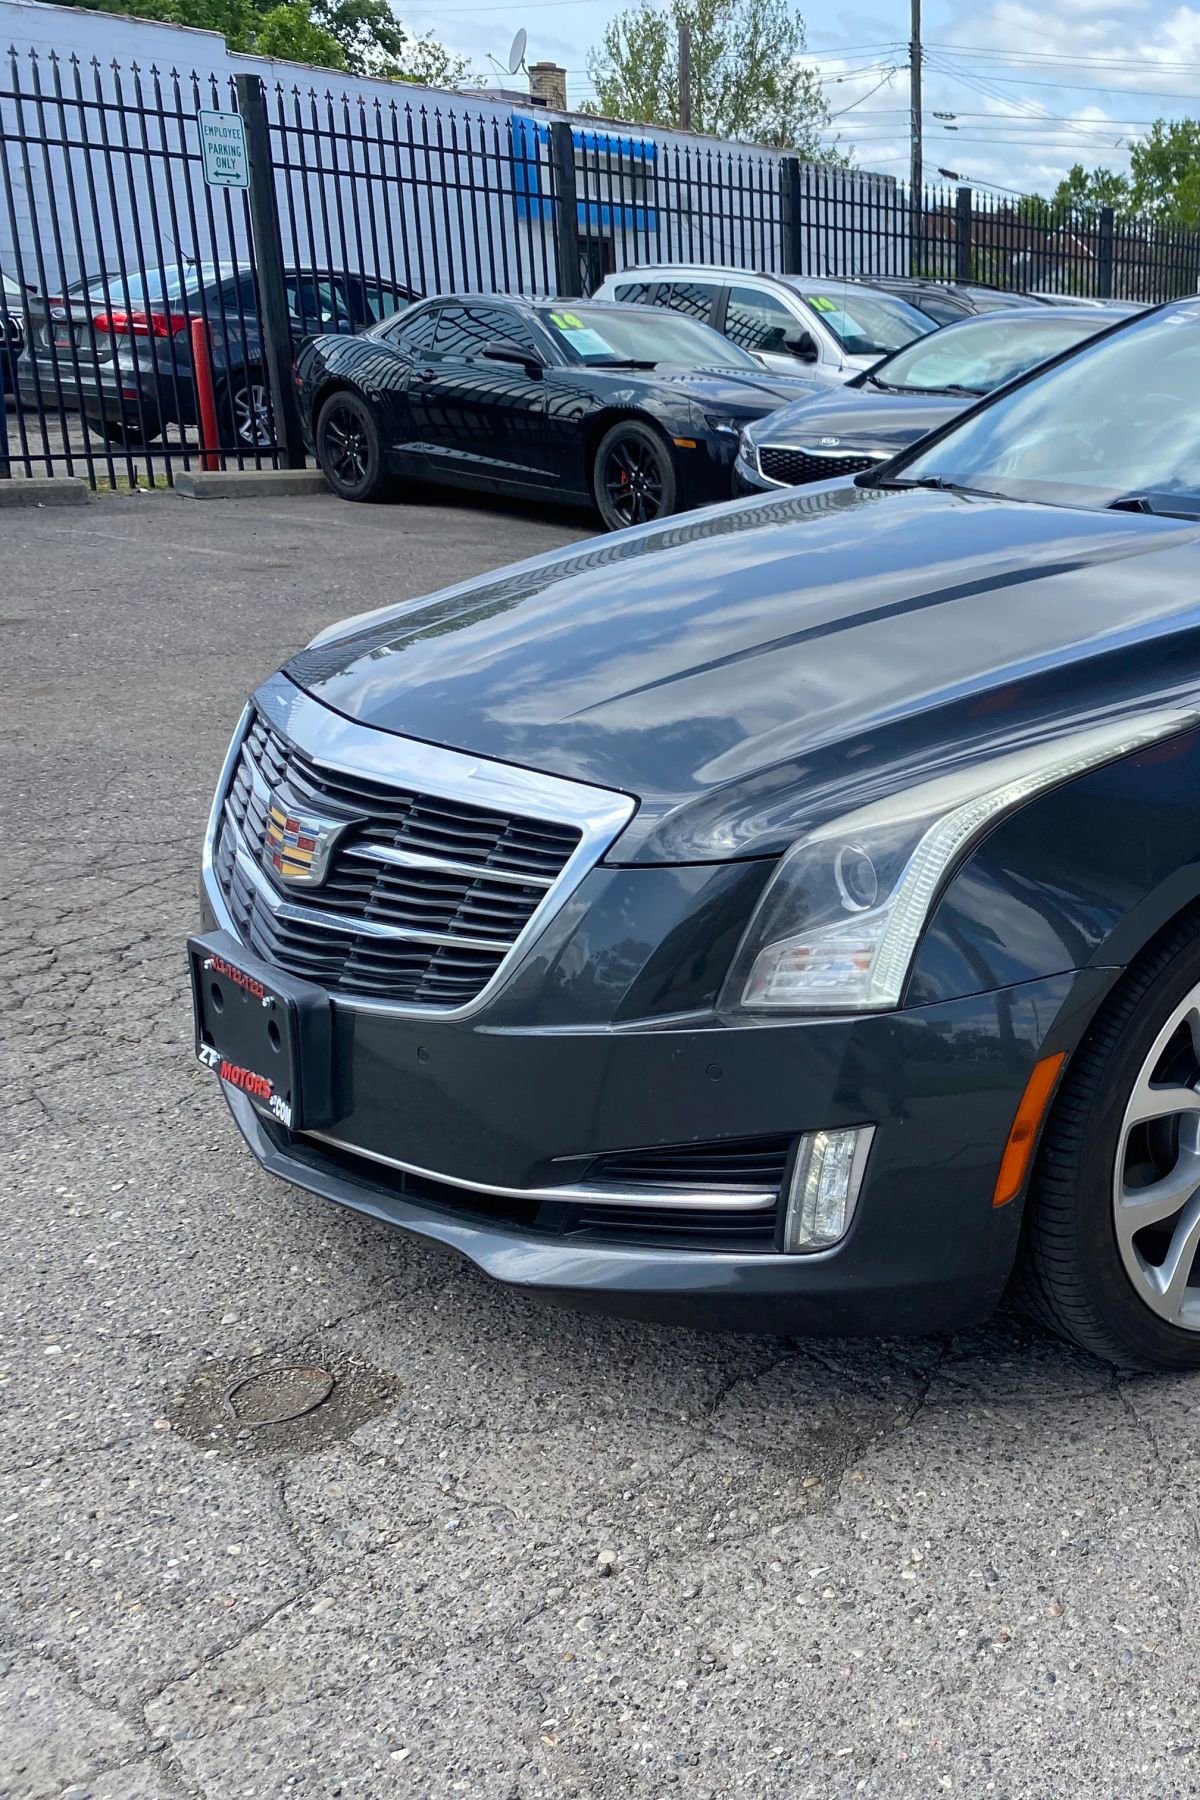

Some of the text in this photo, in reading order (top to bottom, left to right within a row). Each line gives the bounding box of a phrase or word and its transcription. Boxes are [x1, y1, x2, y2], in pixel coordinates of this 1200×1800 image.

[204, 125, 241, 140] EMPLOYEE
[208, 143, 241, 157] PARKING
[216, 156, 236, 169] ONLY
[221, 1060, 271, 1099] MOTORS
[272, 1095, 292, 1128] .COM
